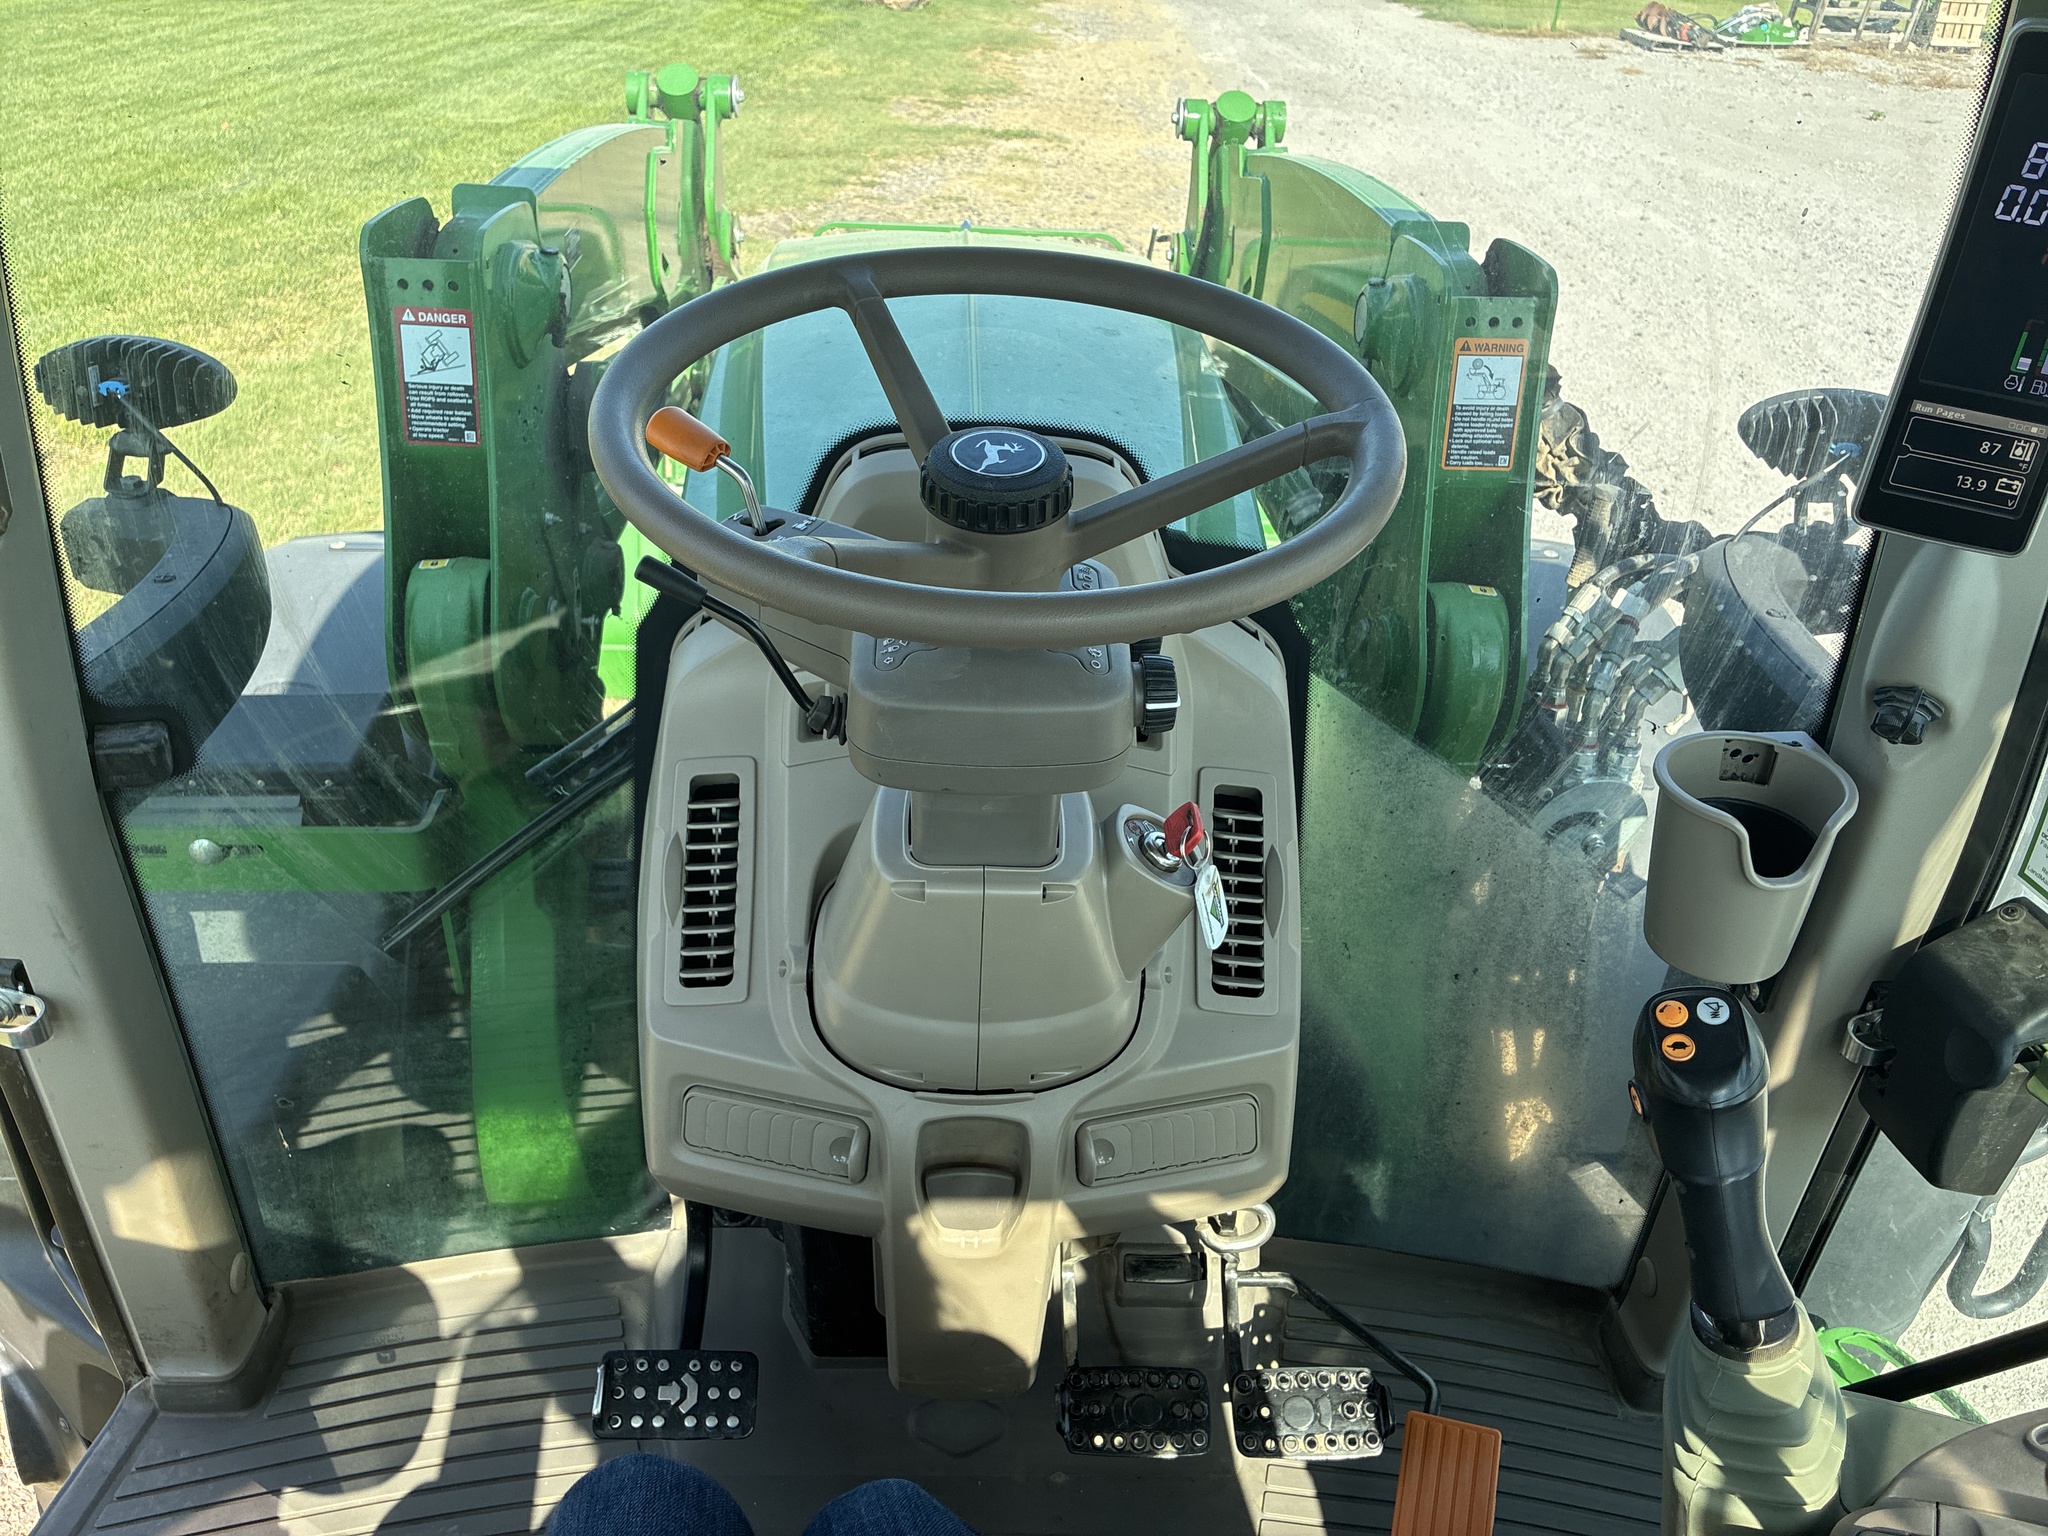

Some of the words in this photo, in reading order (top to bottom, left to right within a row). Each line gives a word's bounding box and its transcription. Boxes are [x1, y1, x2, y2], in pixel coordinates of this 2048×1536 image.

[418, 312, 467, 325] DANGER
[1474, 342, 1525, 353] WARNING
[428, 384, 444, 392] injury
[1915, 402, 1933, 414] Run
[1936, 408, 1966, 422] Pages
[1979, 441, 2002, 456] 87
[1956, 475, 1988, 492] 13.9
[2007, 499, 2016, 508] V
[2027, 865, 2048, 886] LandMa
